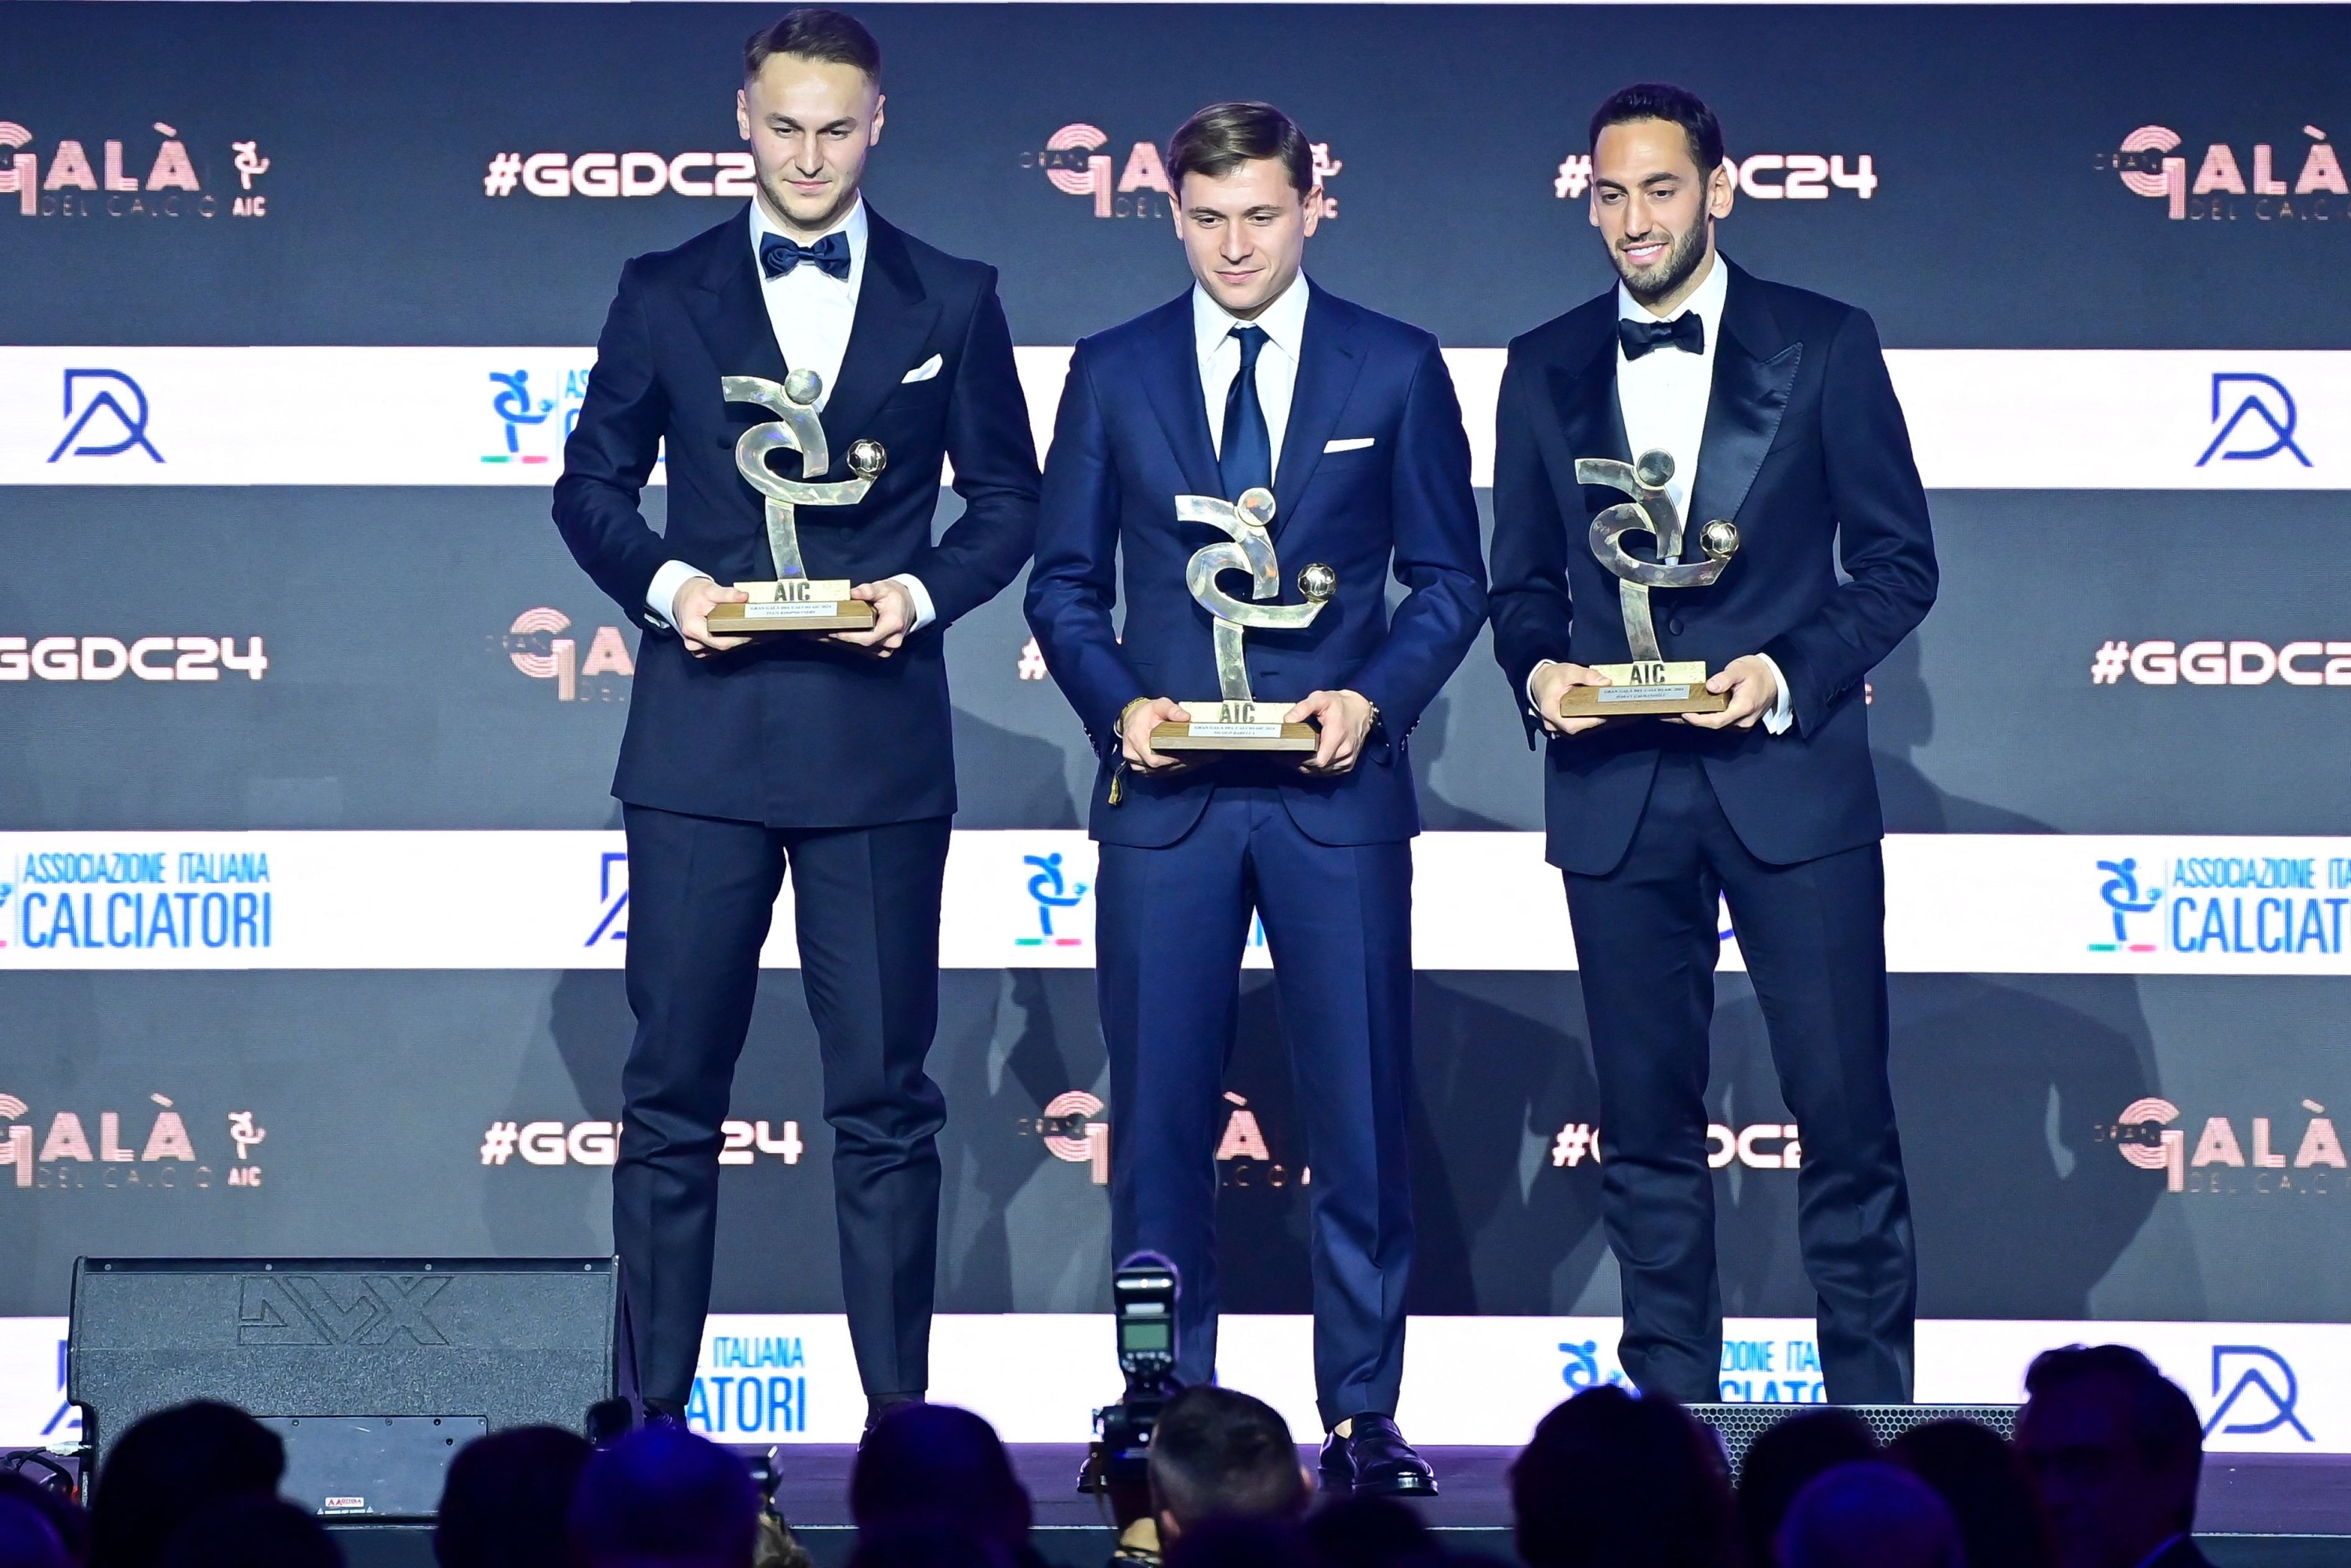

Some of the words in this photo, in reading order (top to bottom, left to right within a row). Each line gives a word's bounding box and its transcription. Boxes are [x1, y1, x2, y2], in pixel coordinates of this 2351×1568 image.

[483, 152, 758, 197] #GGDC2
[1047, 123, 1171, 218] GA
[2120, 125, 2349, 220] GALÀ
[107, 195, 219, 217] CALCO
[774, 581, 810, 601] AIC
[510, 606, 635, 702] GA
[1630, 663, 1665, 685] AIC
[2092, 641, 2351, 684] #GGDC2
[1219, 703, 1256, 724] AIC
[24, 852, 166, 884] ASSOCIAZIONE
[179, 852, 271, 884] ITALIANA
[2173, 857, 2317, 889] ASSOCIAZIONE
[23, 891, 272, 948] CALCIATORI
[2172, 897, 2351, 954] CALCIAT
[480, 1120, 804, 1166] #GG24
[2118, 1097, 2348, 1193] GALÀ
[713, 1337, 805, 1368] ITALIANA
